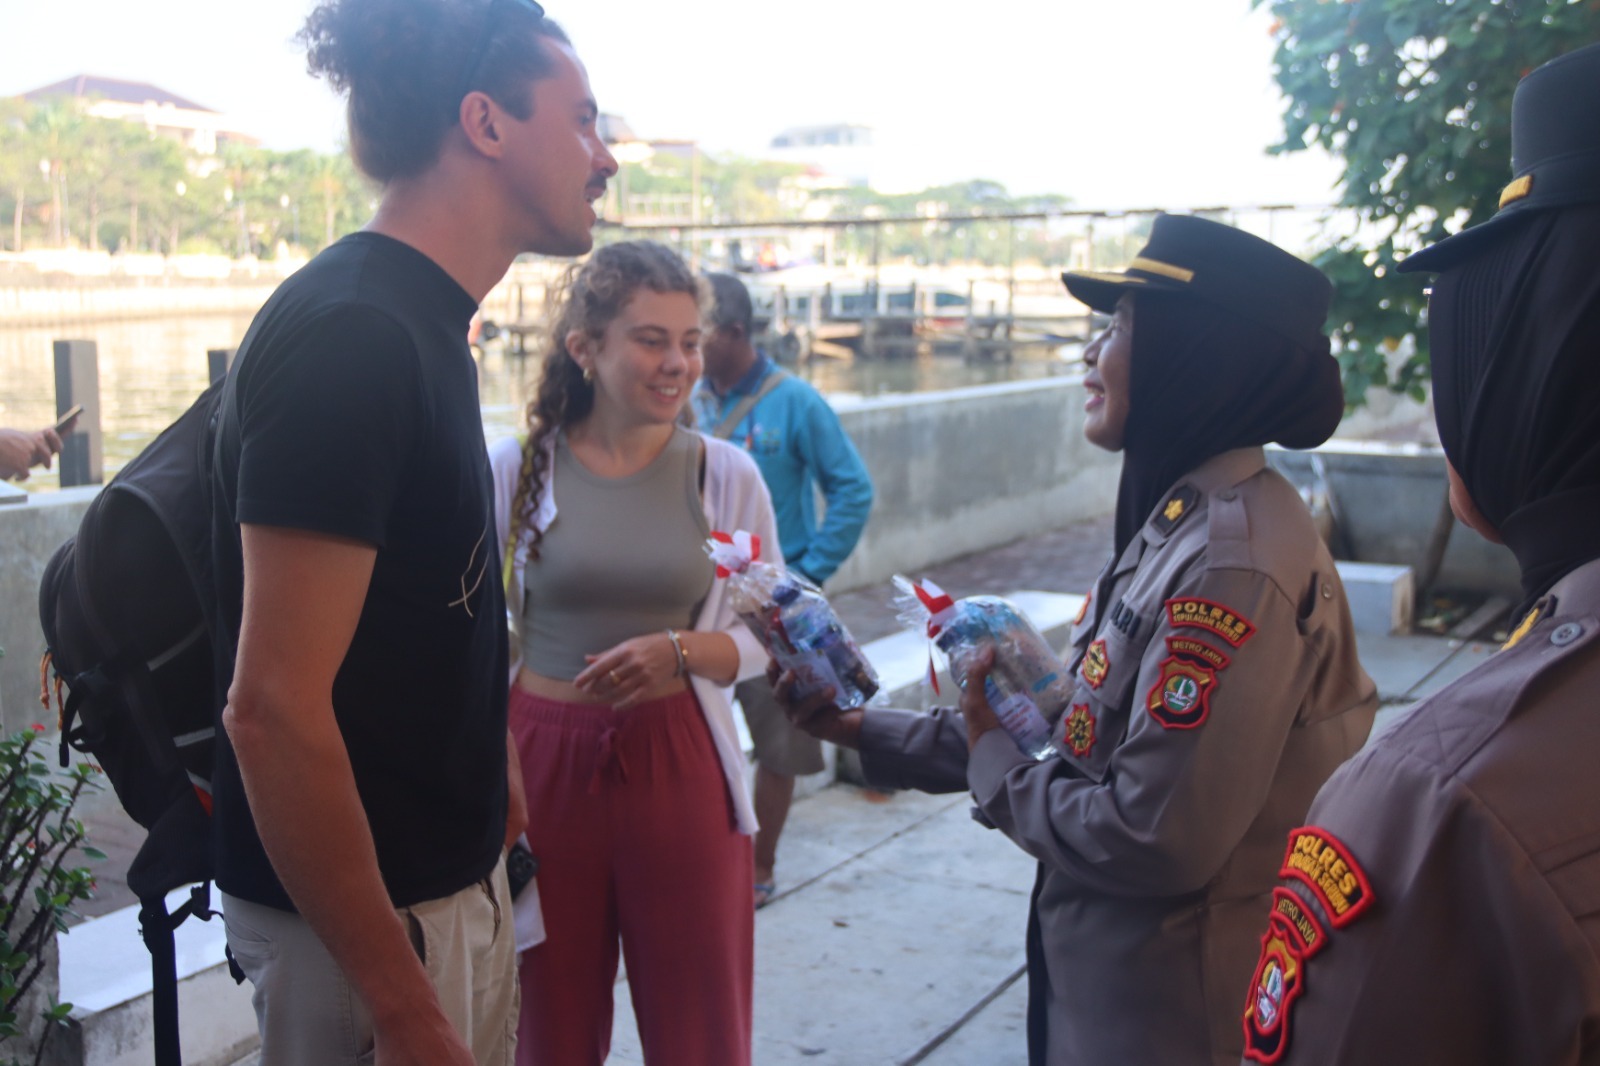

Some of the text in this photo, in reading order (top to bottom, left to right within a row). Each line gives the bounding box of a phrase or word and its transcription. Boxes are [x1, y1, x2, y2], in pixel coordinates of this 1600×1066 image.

[1172, 602, 1246, 634] POLRES
[1172, 641, 1222, 664] METRO JAYA
[1293, 835, 1357, 895] POLRES
[1297, 915, 1316, 945] JAYA
